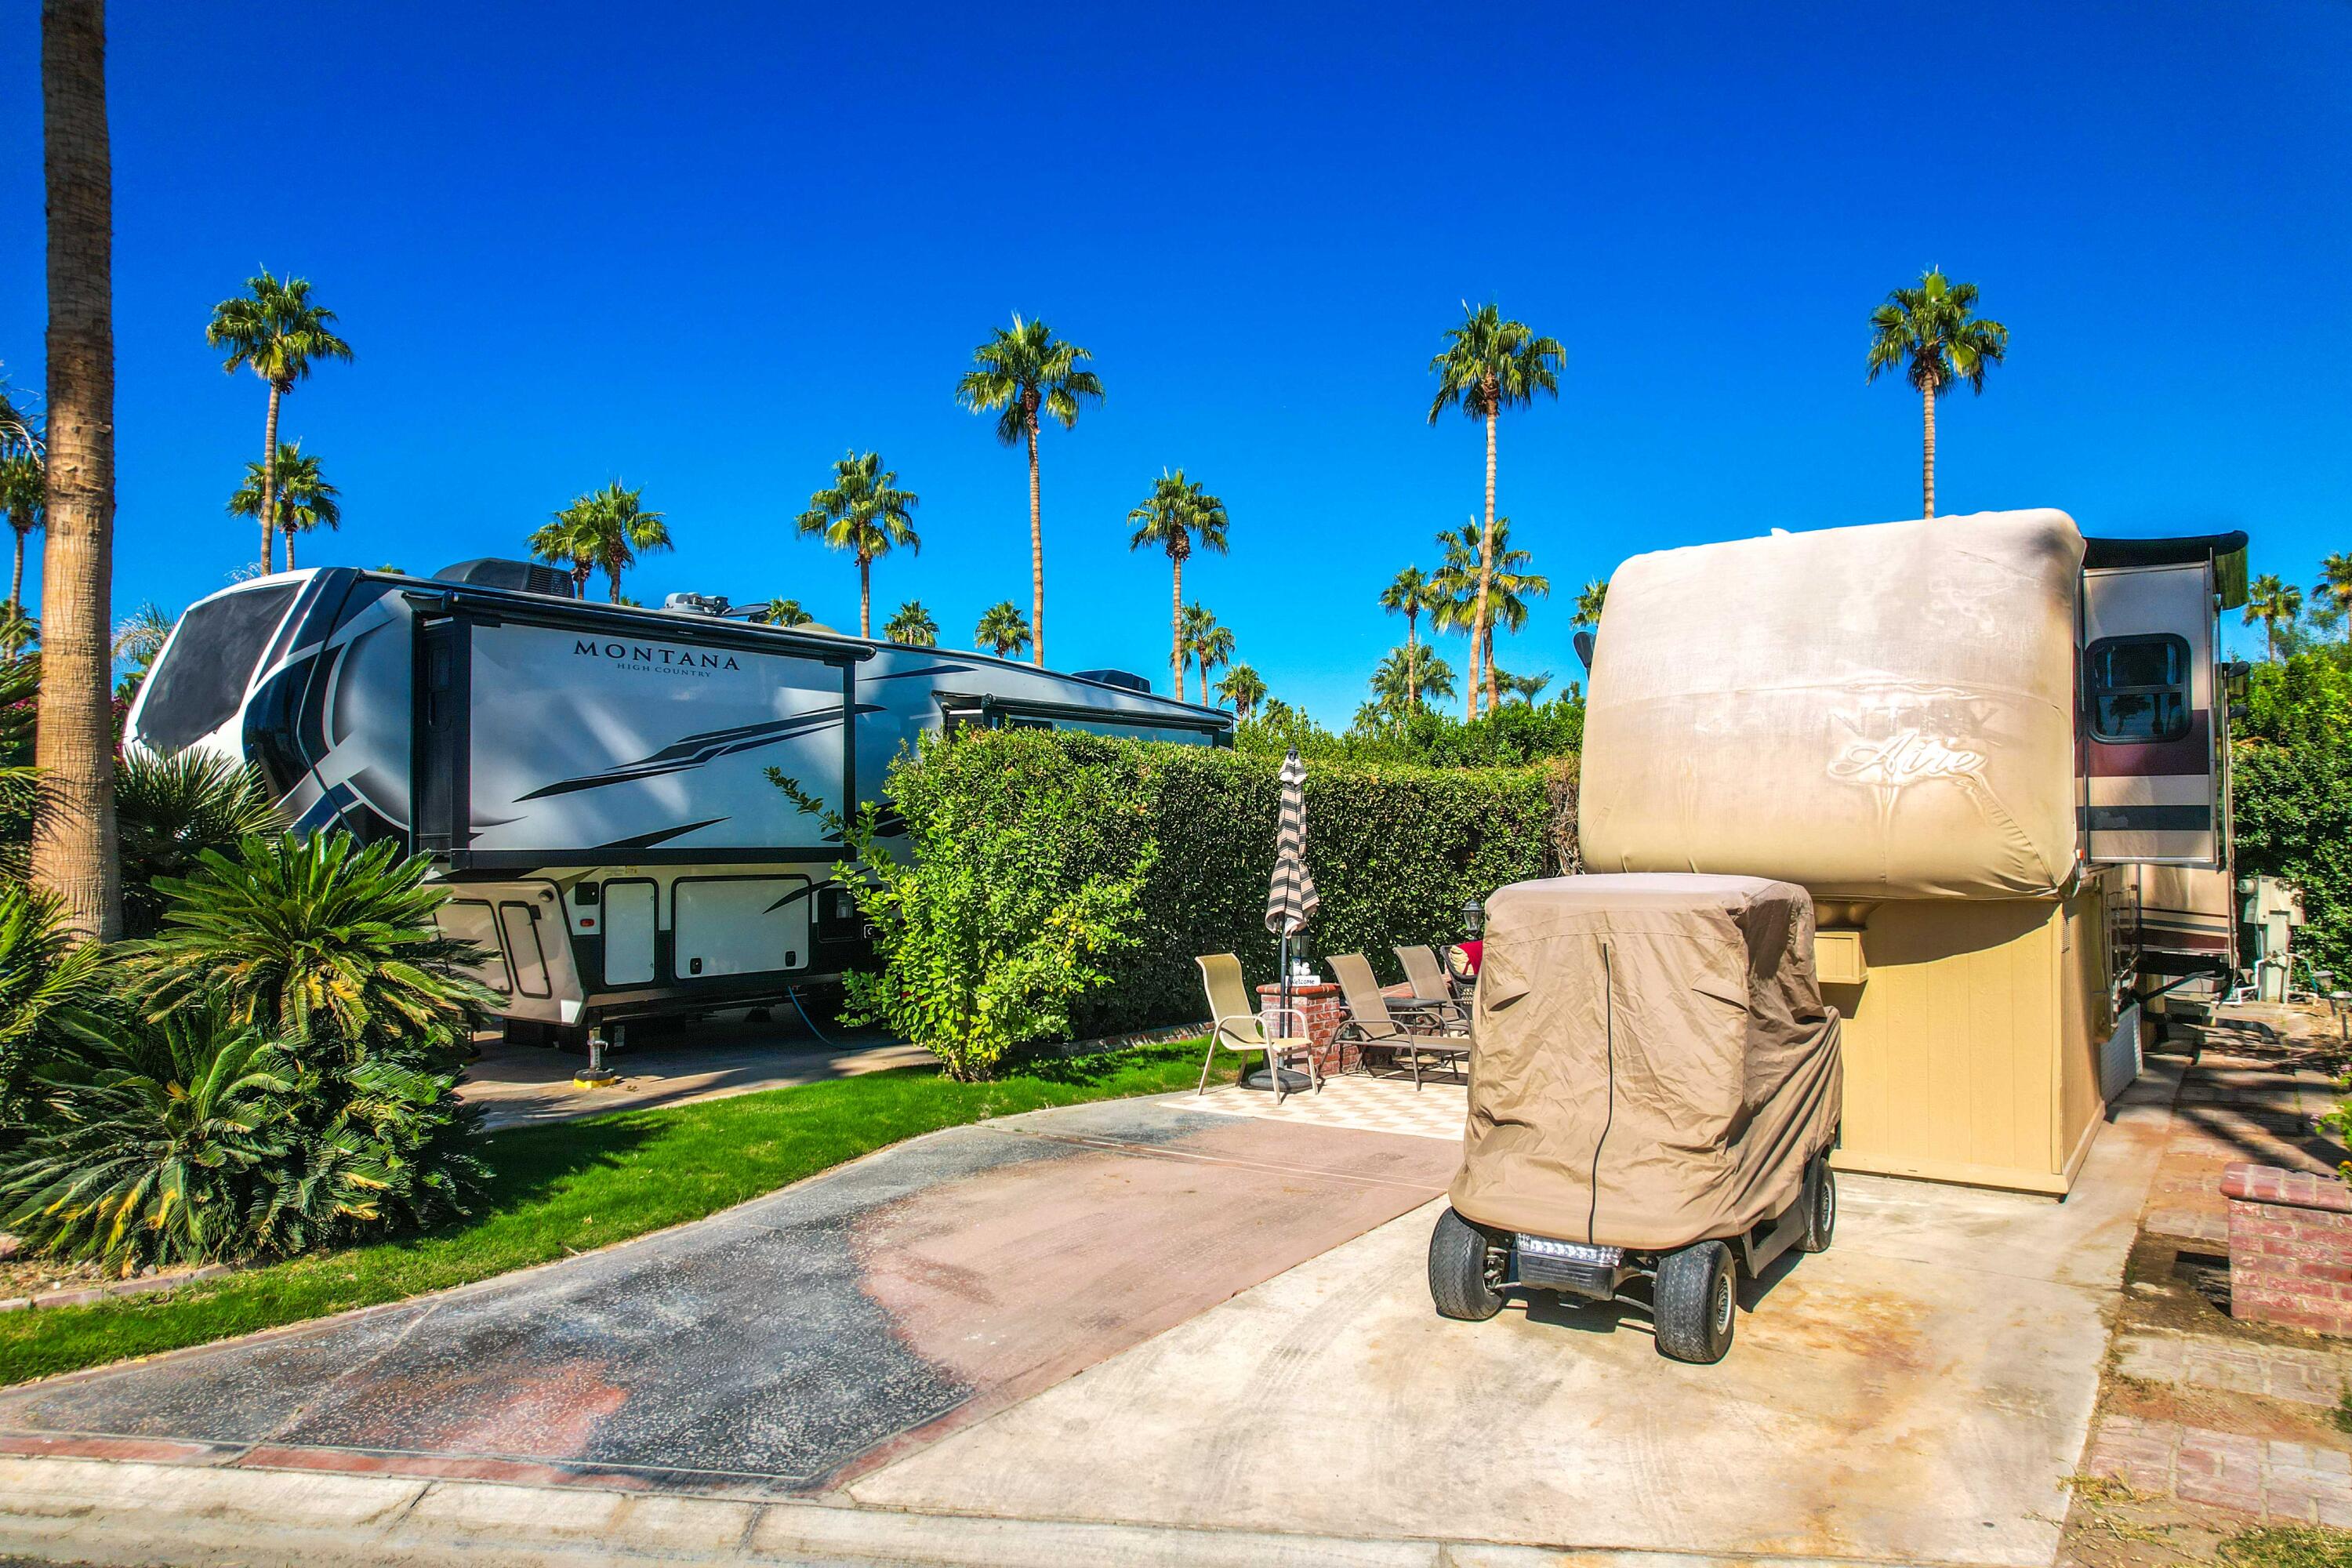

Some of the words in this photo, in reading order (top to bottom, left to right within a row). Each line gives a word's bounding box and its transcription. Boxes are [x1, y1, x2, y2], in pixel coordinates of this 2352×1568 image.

[574, 640, 740, 670] MONTANA
[617, 662, 650, 672] HIGH
[655, 666, 711, 677] COUNTRY
